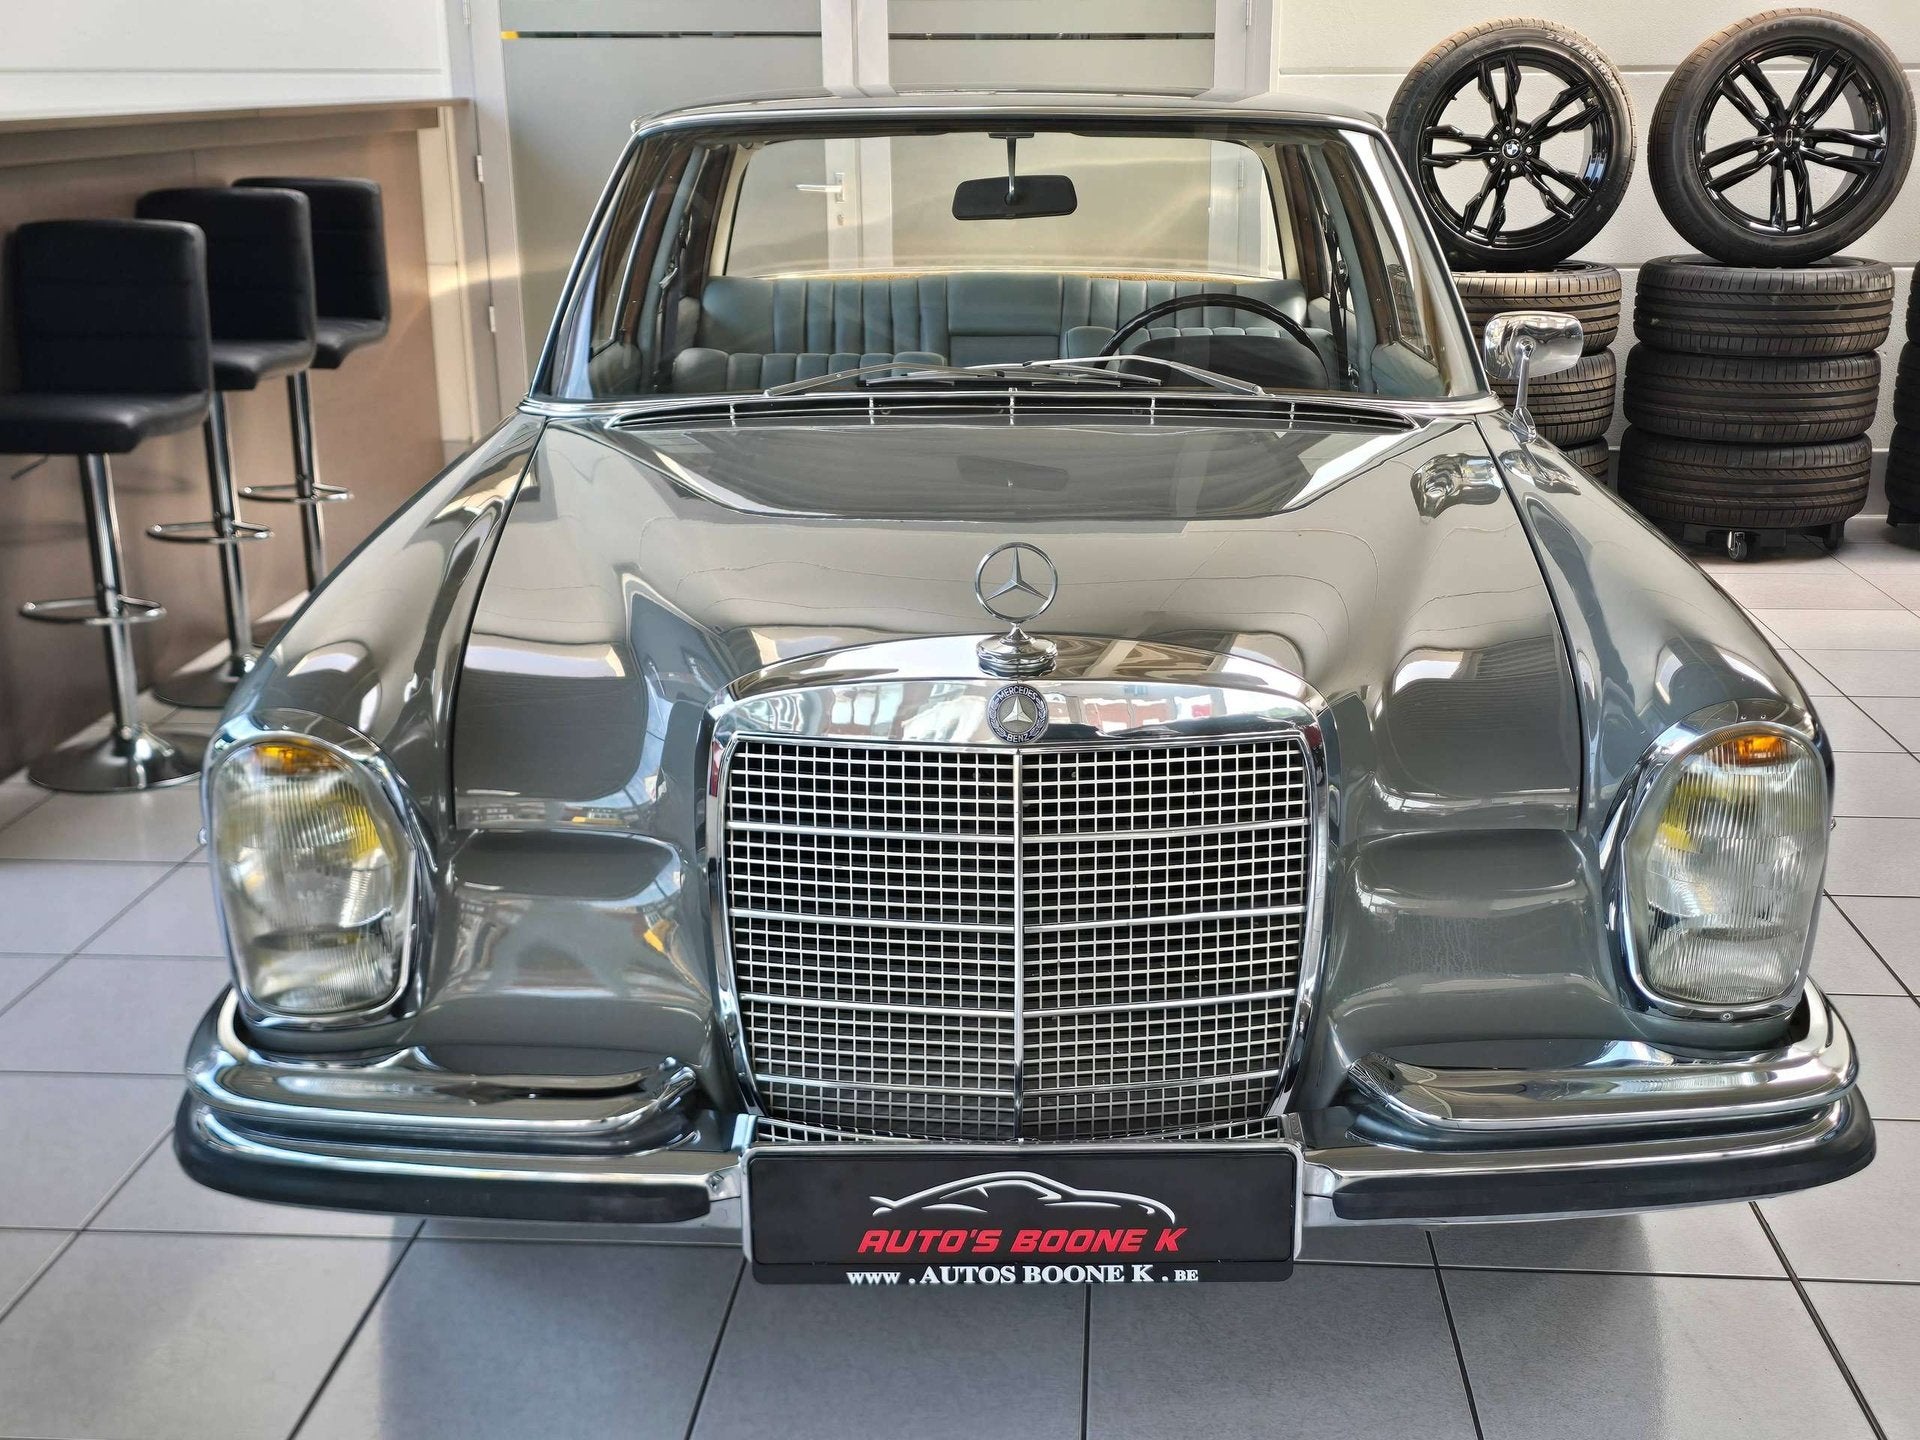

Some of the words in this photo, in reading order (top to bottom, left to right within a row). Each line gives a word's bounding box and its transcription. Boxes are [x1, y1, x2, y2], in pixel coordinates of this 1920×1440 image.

[998, 685, 1038, 701] MERCEDES
[1006, 733, 1030, 743] BENZ
[857, 1229, 1002, 1253] AUTO'S
[1010, 1229, 1148, 1253] BOONE
[1154, 1227, 1188, 1252] K
[1022, 1264, 1124, 1284] BOONE
[1131, 1264, 1154, 1283] K
